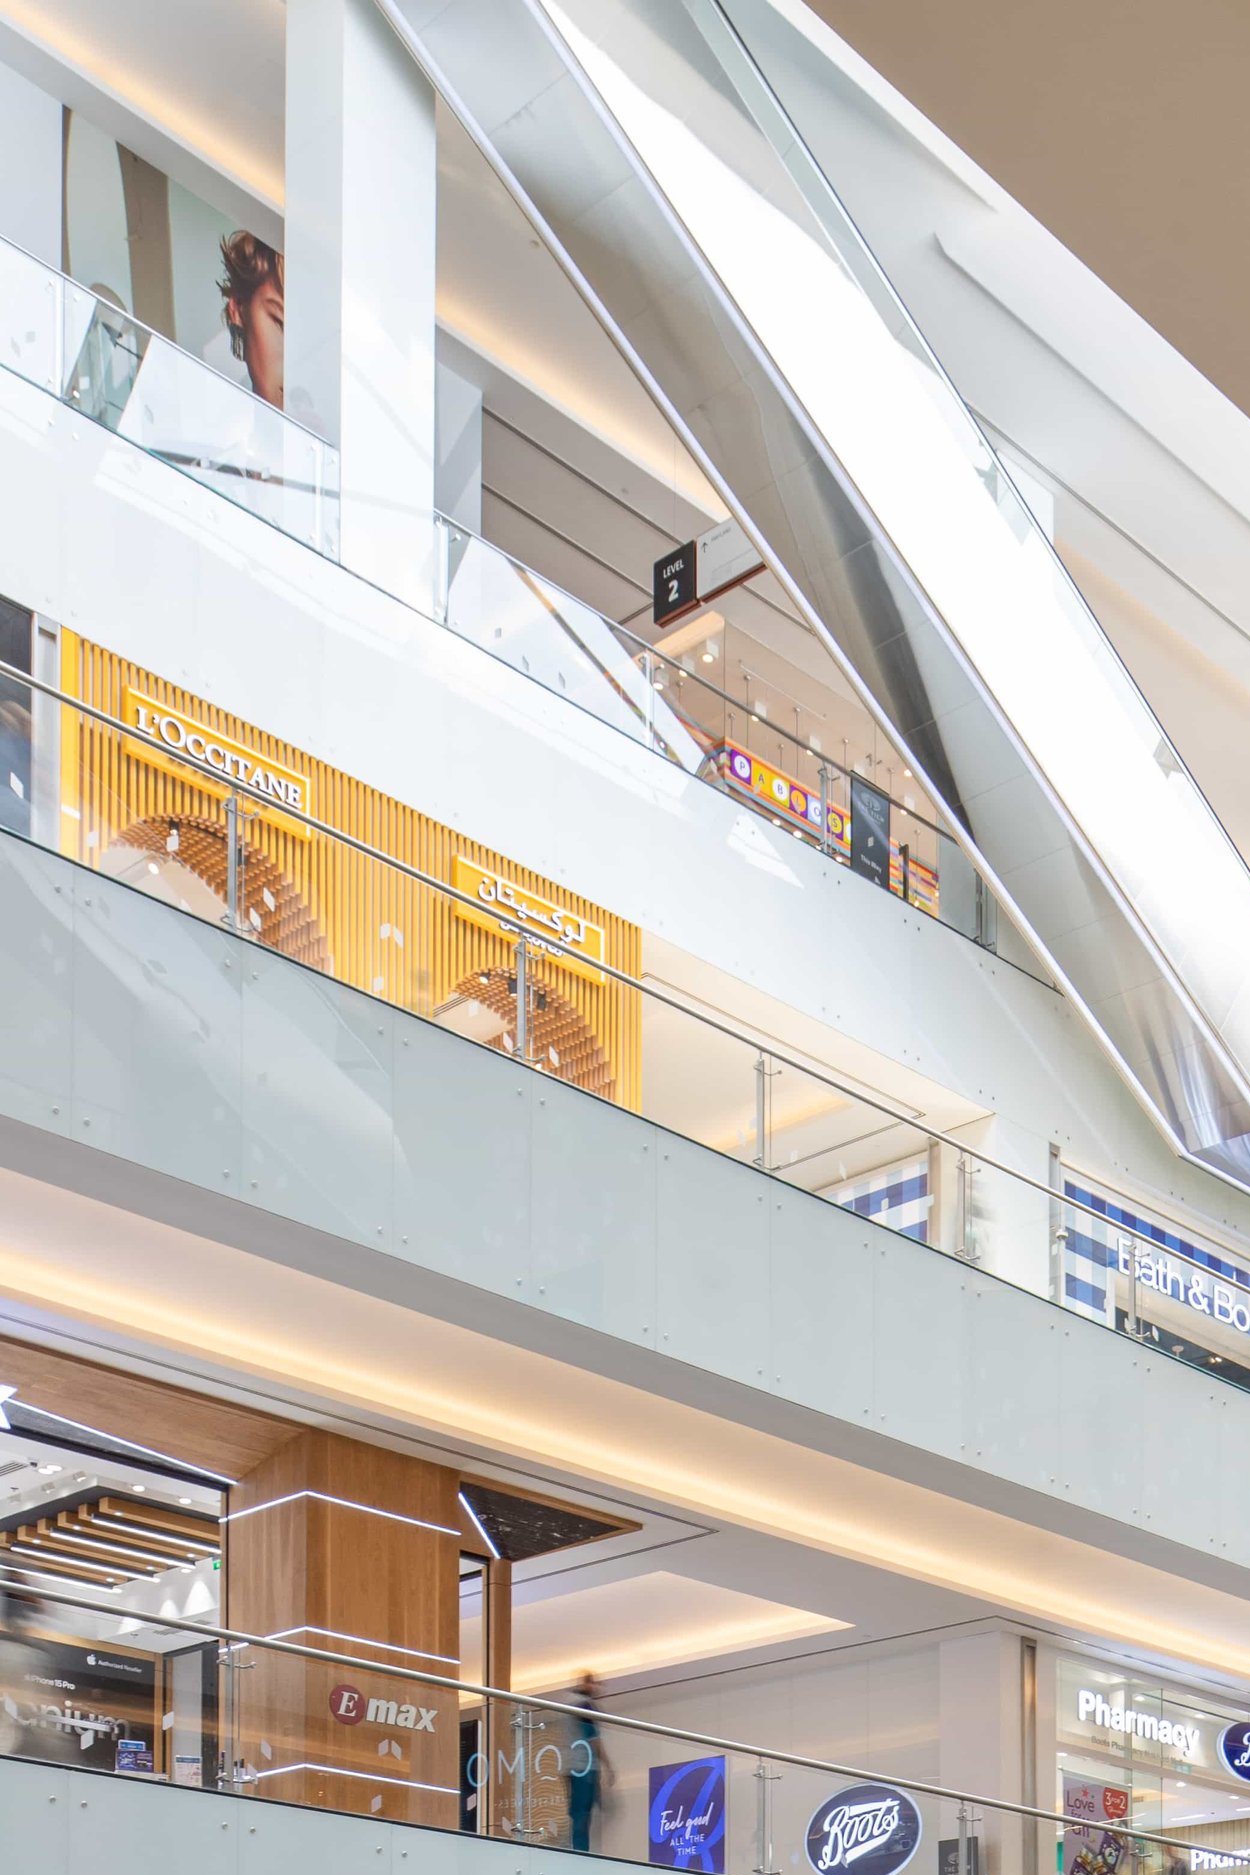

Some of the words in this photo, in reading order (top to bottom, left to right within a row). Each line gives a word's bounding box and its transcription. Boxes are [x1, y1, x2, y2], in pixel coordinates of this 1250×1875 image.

[662, 558, 685, 579] LEVEL
[668, 579, 679, 603] 2
[478, 876, 586, 945] لوكسيتان
[1117, 1237, 1186, 1301] Bath
[1189, 1274, 1211, 1316] &
[62, 1680, 76, 1691] Pro
[1078, 1689, 1200, 1757] Pharmacy
[1066, 1789, 1095, 1813] Love
[1105, 1792, 1112, 1806] 3
[1119, 1795, 1126, 1809] 2
[660, 1804, 684, 1836] Feel
[685, 1801, 714, 1840] good
[669, 1837, 685, 1847] ALL
[689, 1833, 705, 1844] THE
[818, 1797, 901, 1872] Boots
[677, 1845, 697, 1856] TIME
